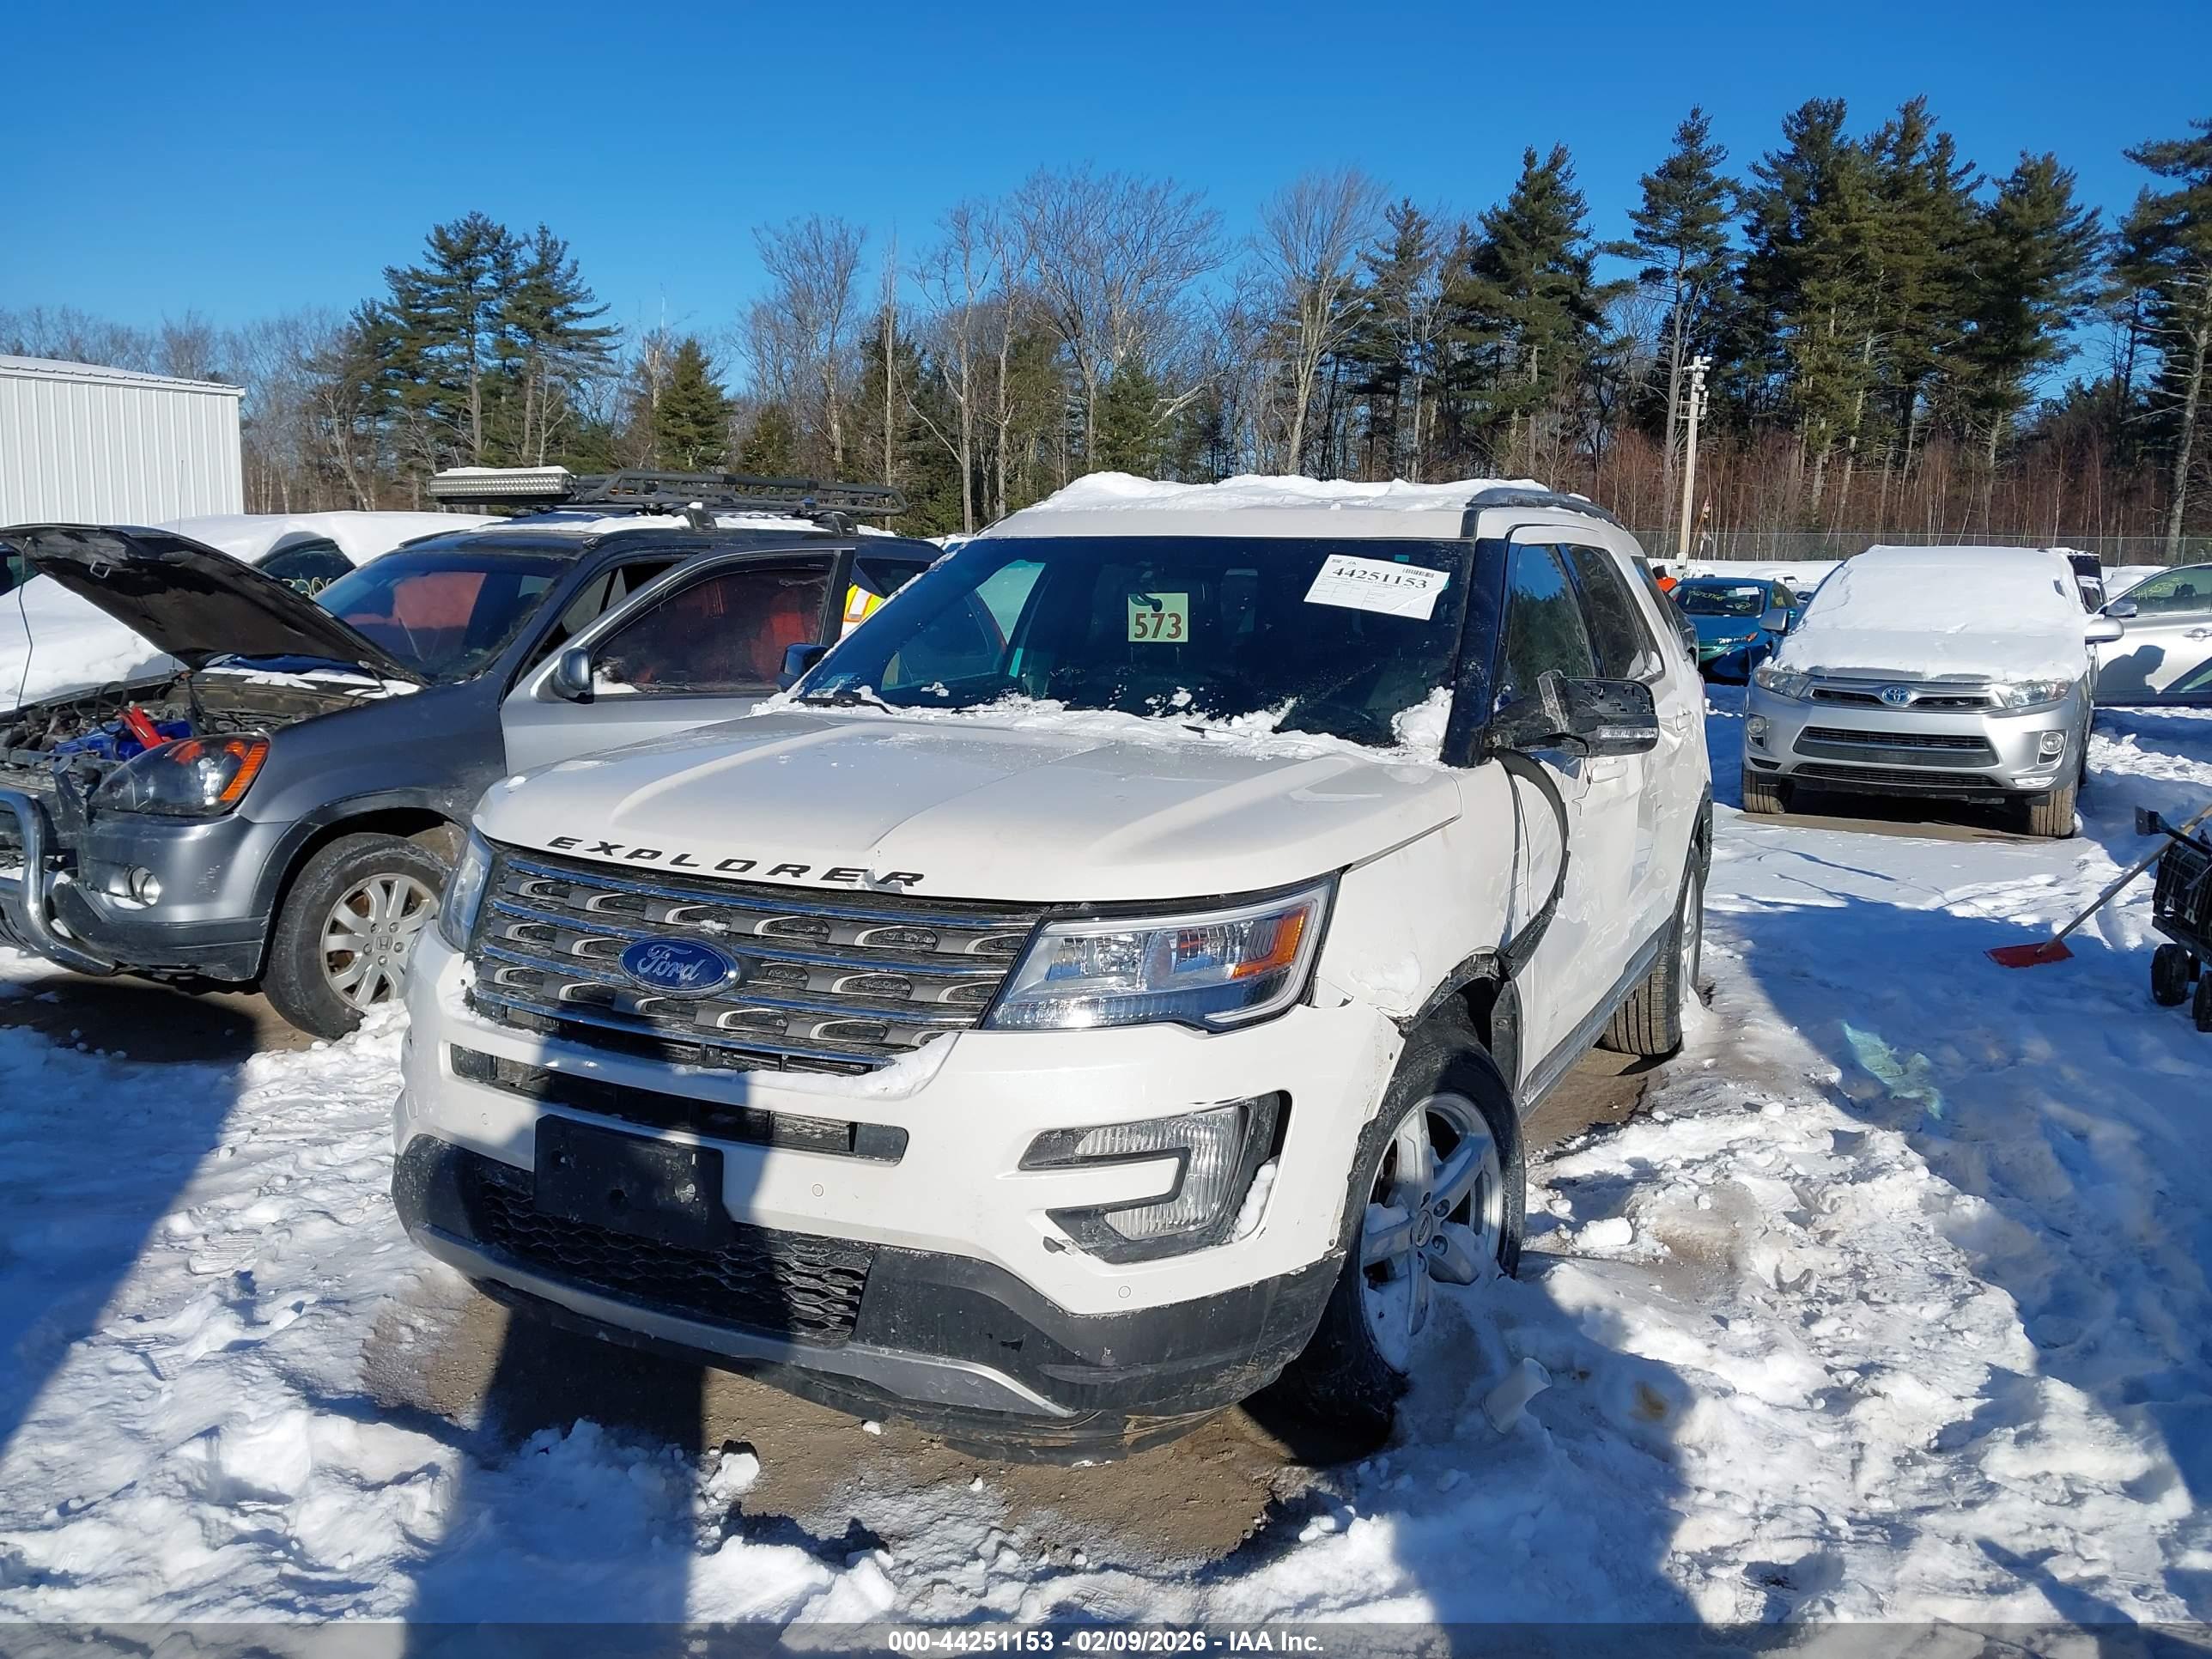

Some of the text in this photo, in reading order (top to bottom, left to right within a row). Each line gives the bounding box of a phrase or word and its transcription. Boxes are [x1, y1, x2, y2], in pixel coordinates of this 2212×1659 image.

[1332, 567, 1428, 589] 44251153
[1133, 612, 1182, 640] 573
[547, 836, 925, 886] EXPLORER
[637, 945, 708, 981] Ford
